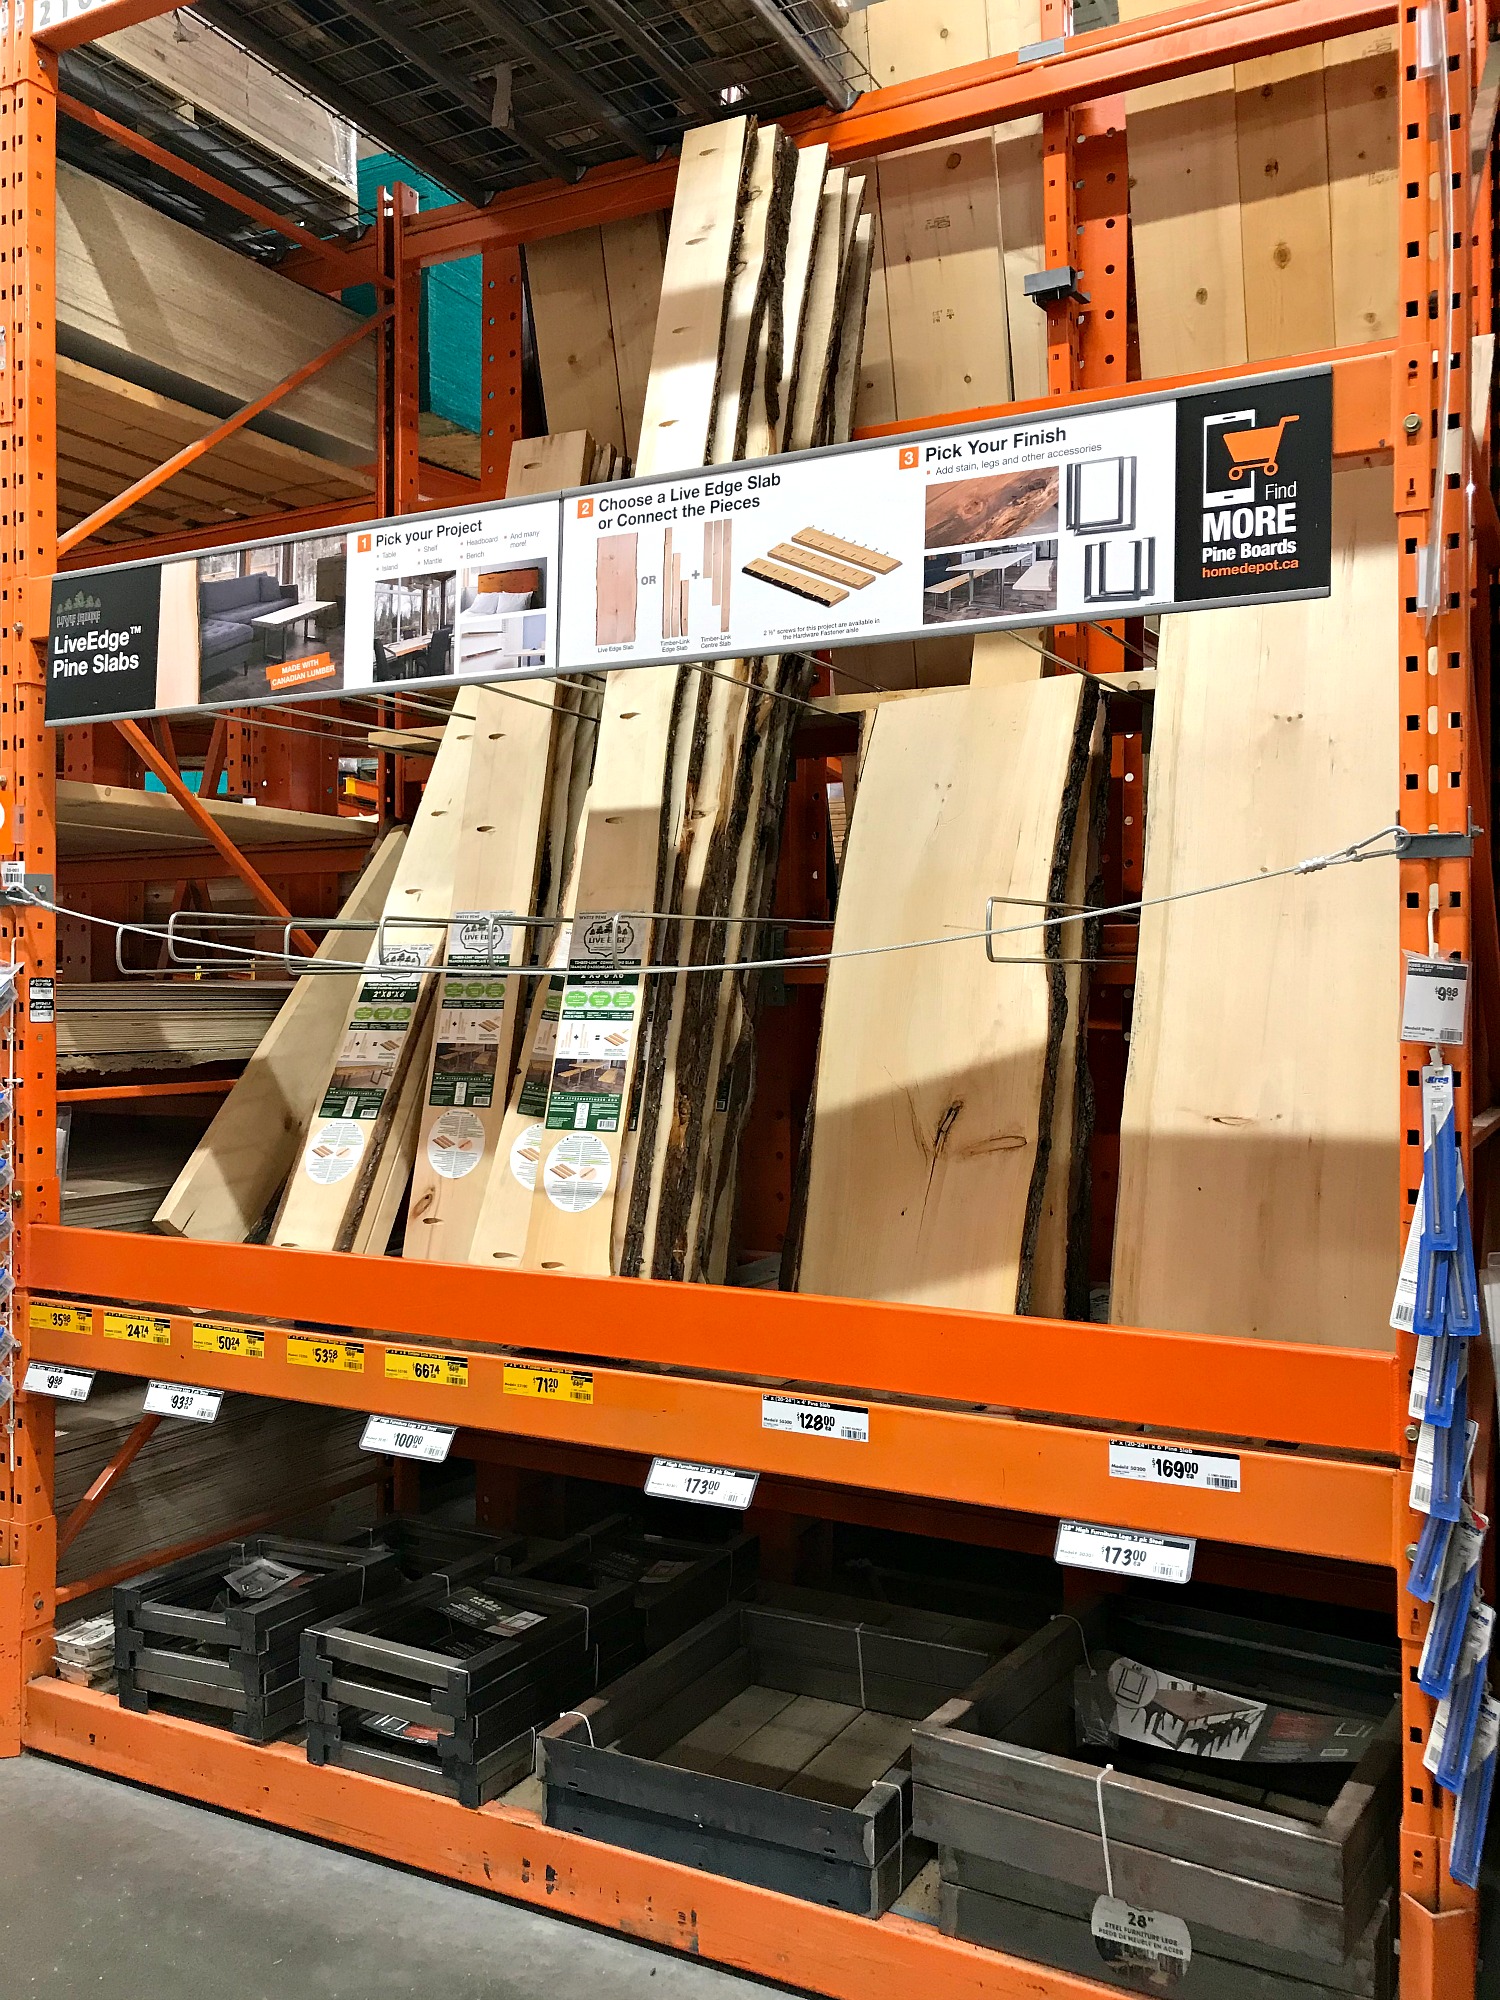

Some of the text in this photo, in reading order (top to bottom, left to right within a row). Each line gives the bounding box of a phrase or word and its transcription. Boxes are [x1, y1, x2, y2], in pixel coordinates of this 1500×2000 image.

[904, 427, 1067, 465] 3 Pick Your Finish
[935, 443, 1102, 476] Add stain, legs and other accessories
[581, 473, 781, 515] 2 Choose a Live Edge Slab
[1265, 480, 1297, 501] Find
[598, 496, 760, 530] or Connect the Pieces
[1202, 502, 1297, 543] MORE
[361, 519, 483, 549] 1 Pick your Project
[466, 536, 499, 547] Headboard
[510, 530, 540, 540] And many
[424, 544, 438, 553] Shelf
[510, 540, 527, 549] more!
[1202, 538, 1298, 563] Pine Boards
[382, 551, 397, 559] Table
[423, 557, 443, 566] Mantle
[466, 551, 485, 560] Bench
[381, 564, 398, 572] Island
[1202, 558, 1299, 579] homedepot.ca
[641, 575, 656, 585] OR
[817, 623, 837, 631] project
[848, 619, 874, 627] available
[661, 638, 690, 647] Timber-Link
[793, 631, 819, 639] Hardware
[53, 652, 140, 679] Pine Slabs
[281, 658, 319, 675] MADE WITH
[271, 665, 335, 687] CANADIAN LUMBER
[588, 936, 626, 944] LIVE EGE
[1427, 1076, 1449, 1084] Kreg
[1075, 1526, 1089, 1535] High
[1091, 1529, 1117, 1538] Furniture
[1119, 1533, 1132, 1542] Legs
[1149, 1537, 1164, 1546] Steel
[1127, 1912, 1154, 1928] 28"
[1104, 1922, 1178, 1946] STEEL FURNITURE LEGS
